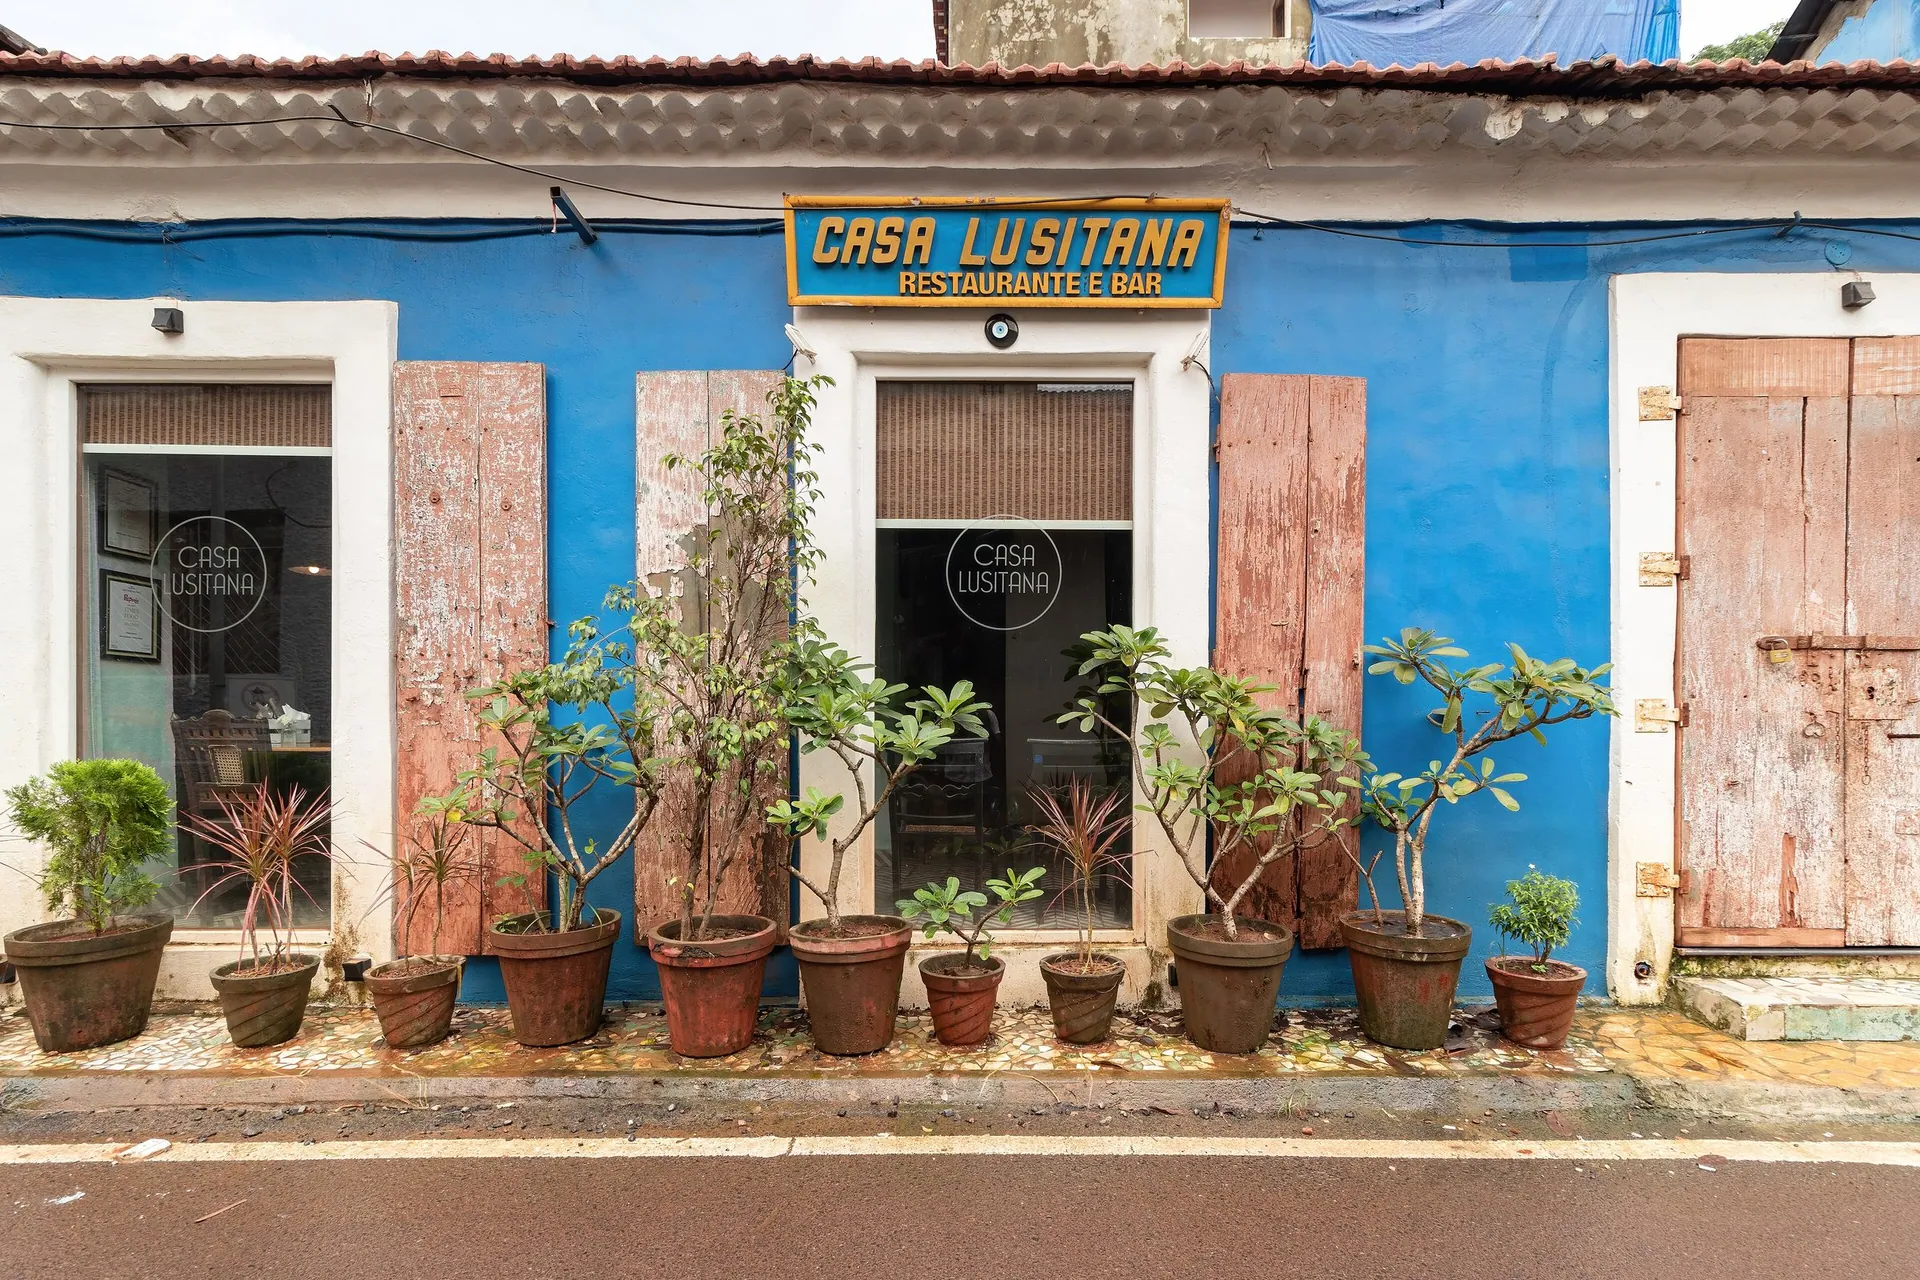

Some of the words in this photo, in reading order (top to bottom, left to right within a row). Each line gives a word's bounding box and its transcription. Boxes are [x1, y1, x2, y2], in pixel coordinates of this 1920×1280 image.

[811, 216, 936, 266] CASA
[959, 217, 1205, 268] LUSITANA
[899, 271, 1081, 296] RESTAURANTE
[1088, 272, 1103, 296] E
[1111, 272, 1163, 296] BAR
[178, 546, 240, 569] CASA
[973, 543, 1035, 567] CASA
[163, 572, 254, 596] LUSITANA
[958, 570, 1049, 594] LUSITANA
